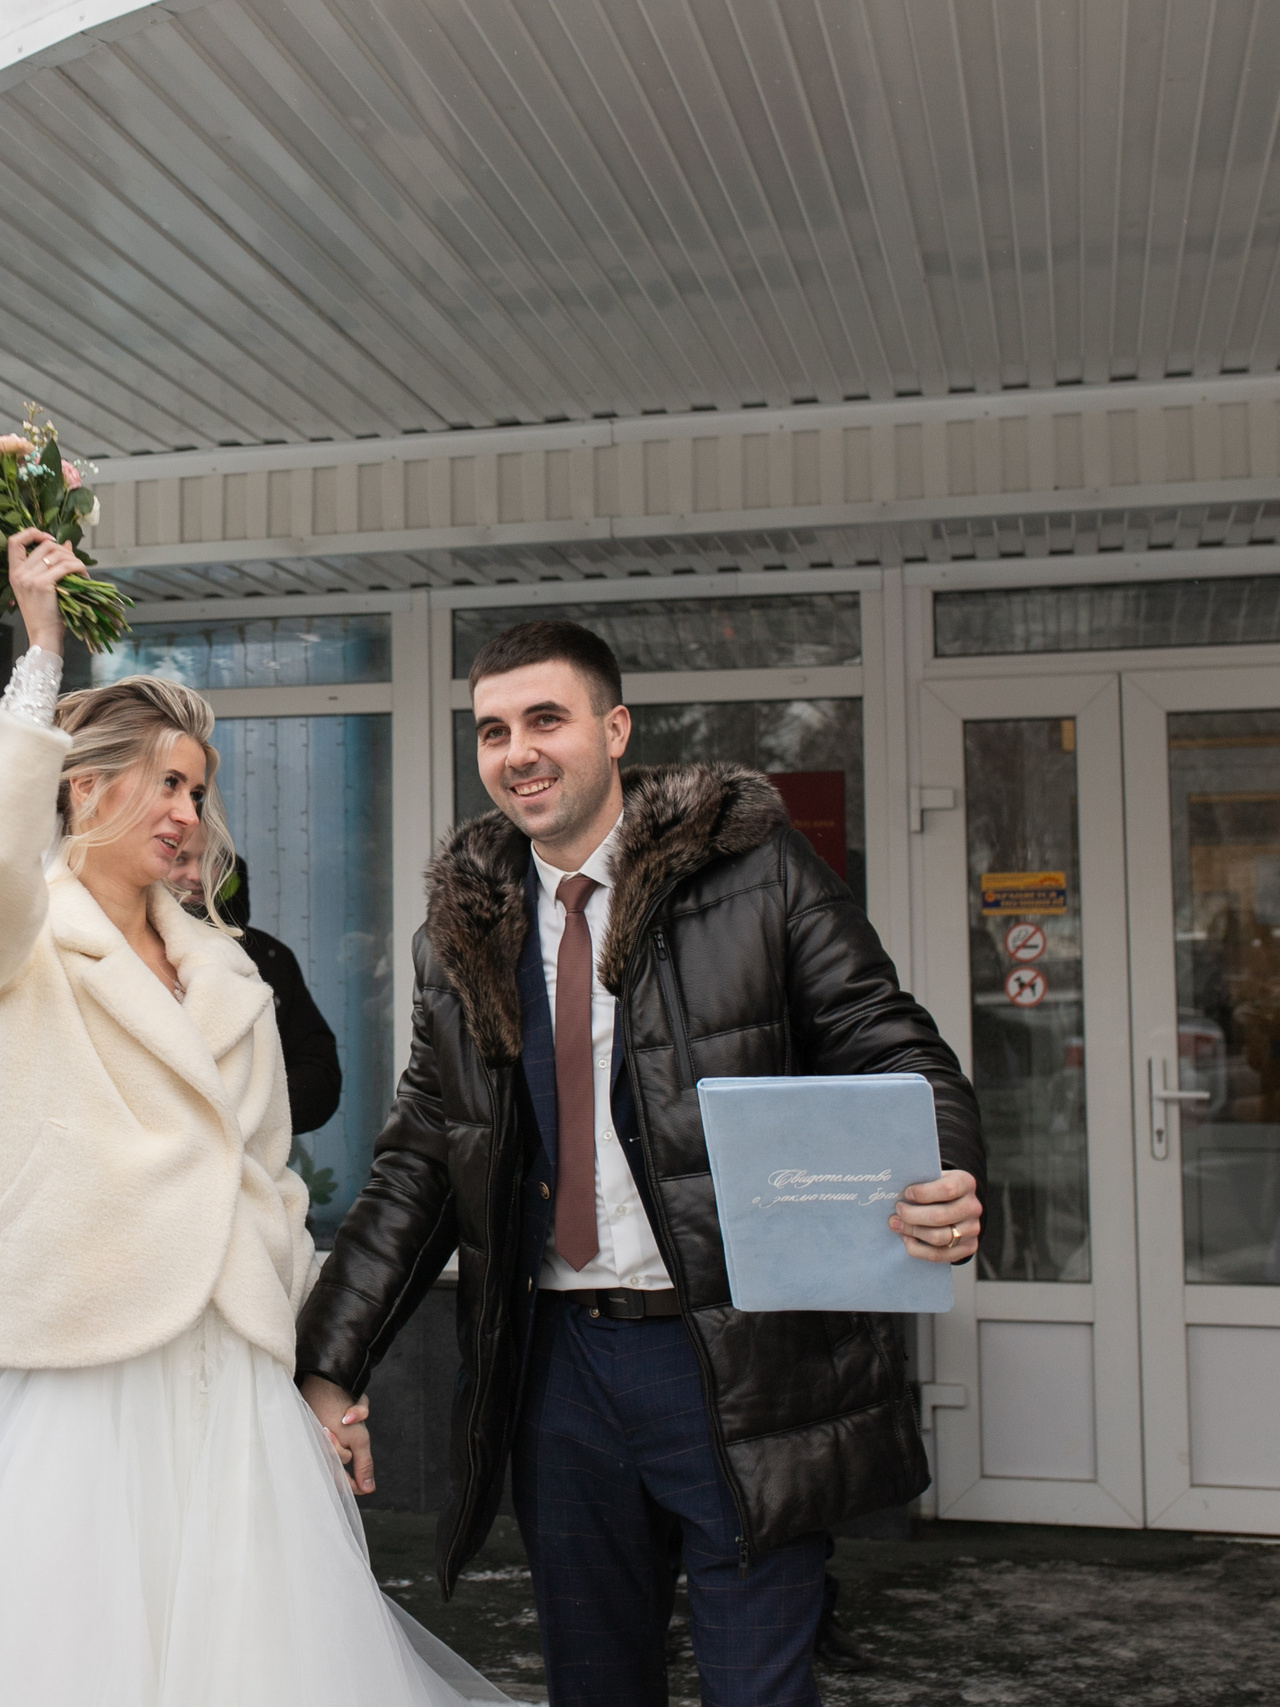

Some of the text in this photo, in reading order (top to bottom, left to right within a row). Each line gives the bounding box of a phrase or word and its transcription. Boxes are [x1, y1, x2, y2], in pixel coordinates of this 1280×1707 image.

[768, 1168, 892, 1189] Свидетельство
[752, 1196, 761, 1204] о
[759, 1192, 858, 1209] заключении
